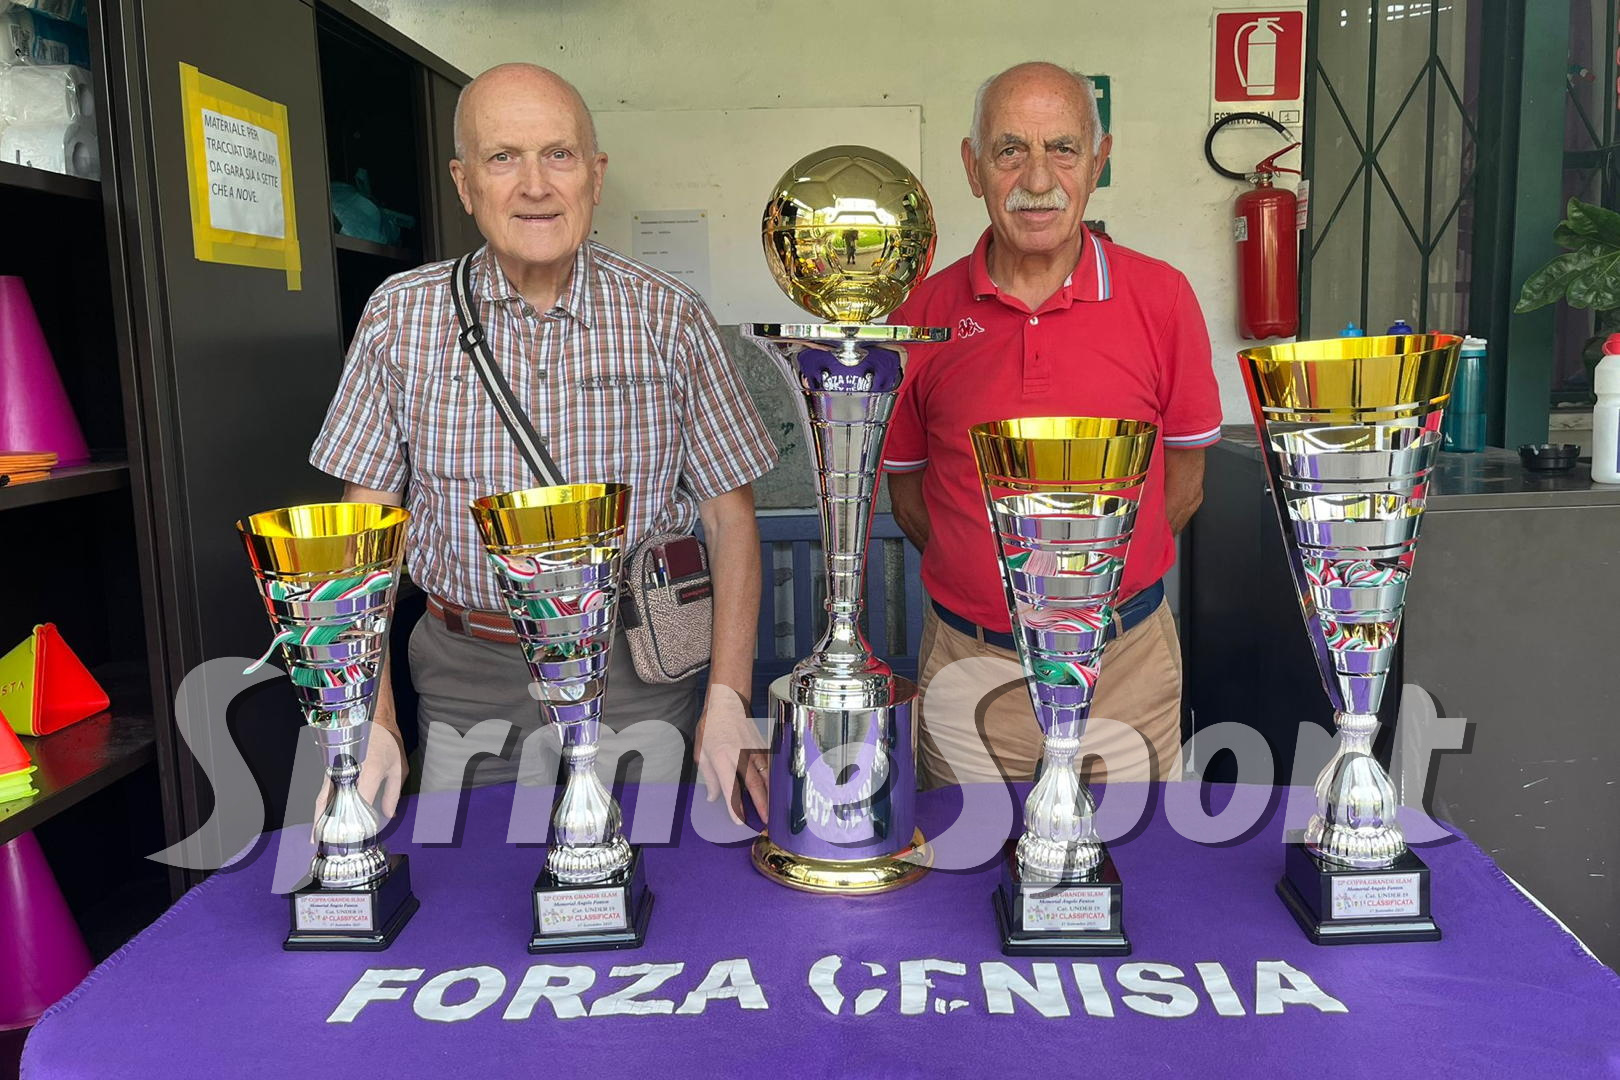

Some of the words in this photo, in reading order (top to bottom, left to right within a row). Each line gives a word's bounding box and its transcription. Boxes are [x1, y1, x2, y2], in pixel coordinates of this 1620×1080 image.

[204, 114, 246, 137] MATERIALE
[247, 126, 259, 141] PER
[206, 137, 258, 158] TRACCIATURA
[258, 151, 277, 167] CAMPI
[209, 160, 223, 174] DA
[224, 163, 245, 180] GARA
[245, 168, 256, 181] SIA
[261, 173, 278, 188] SETTE
[211, 183, 229, 197] CHE
[229, 186, 234, 197] A
[575, 912, 621, 921] CLASSIFICATA
[1059, 912, 1105, 920] CLASSIFICATA
[326, 958, 769, 1023] FORZA
[808, 955, 1349, 1018] CENISIA
